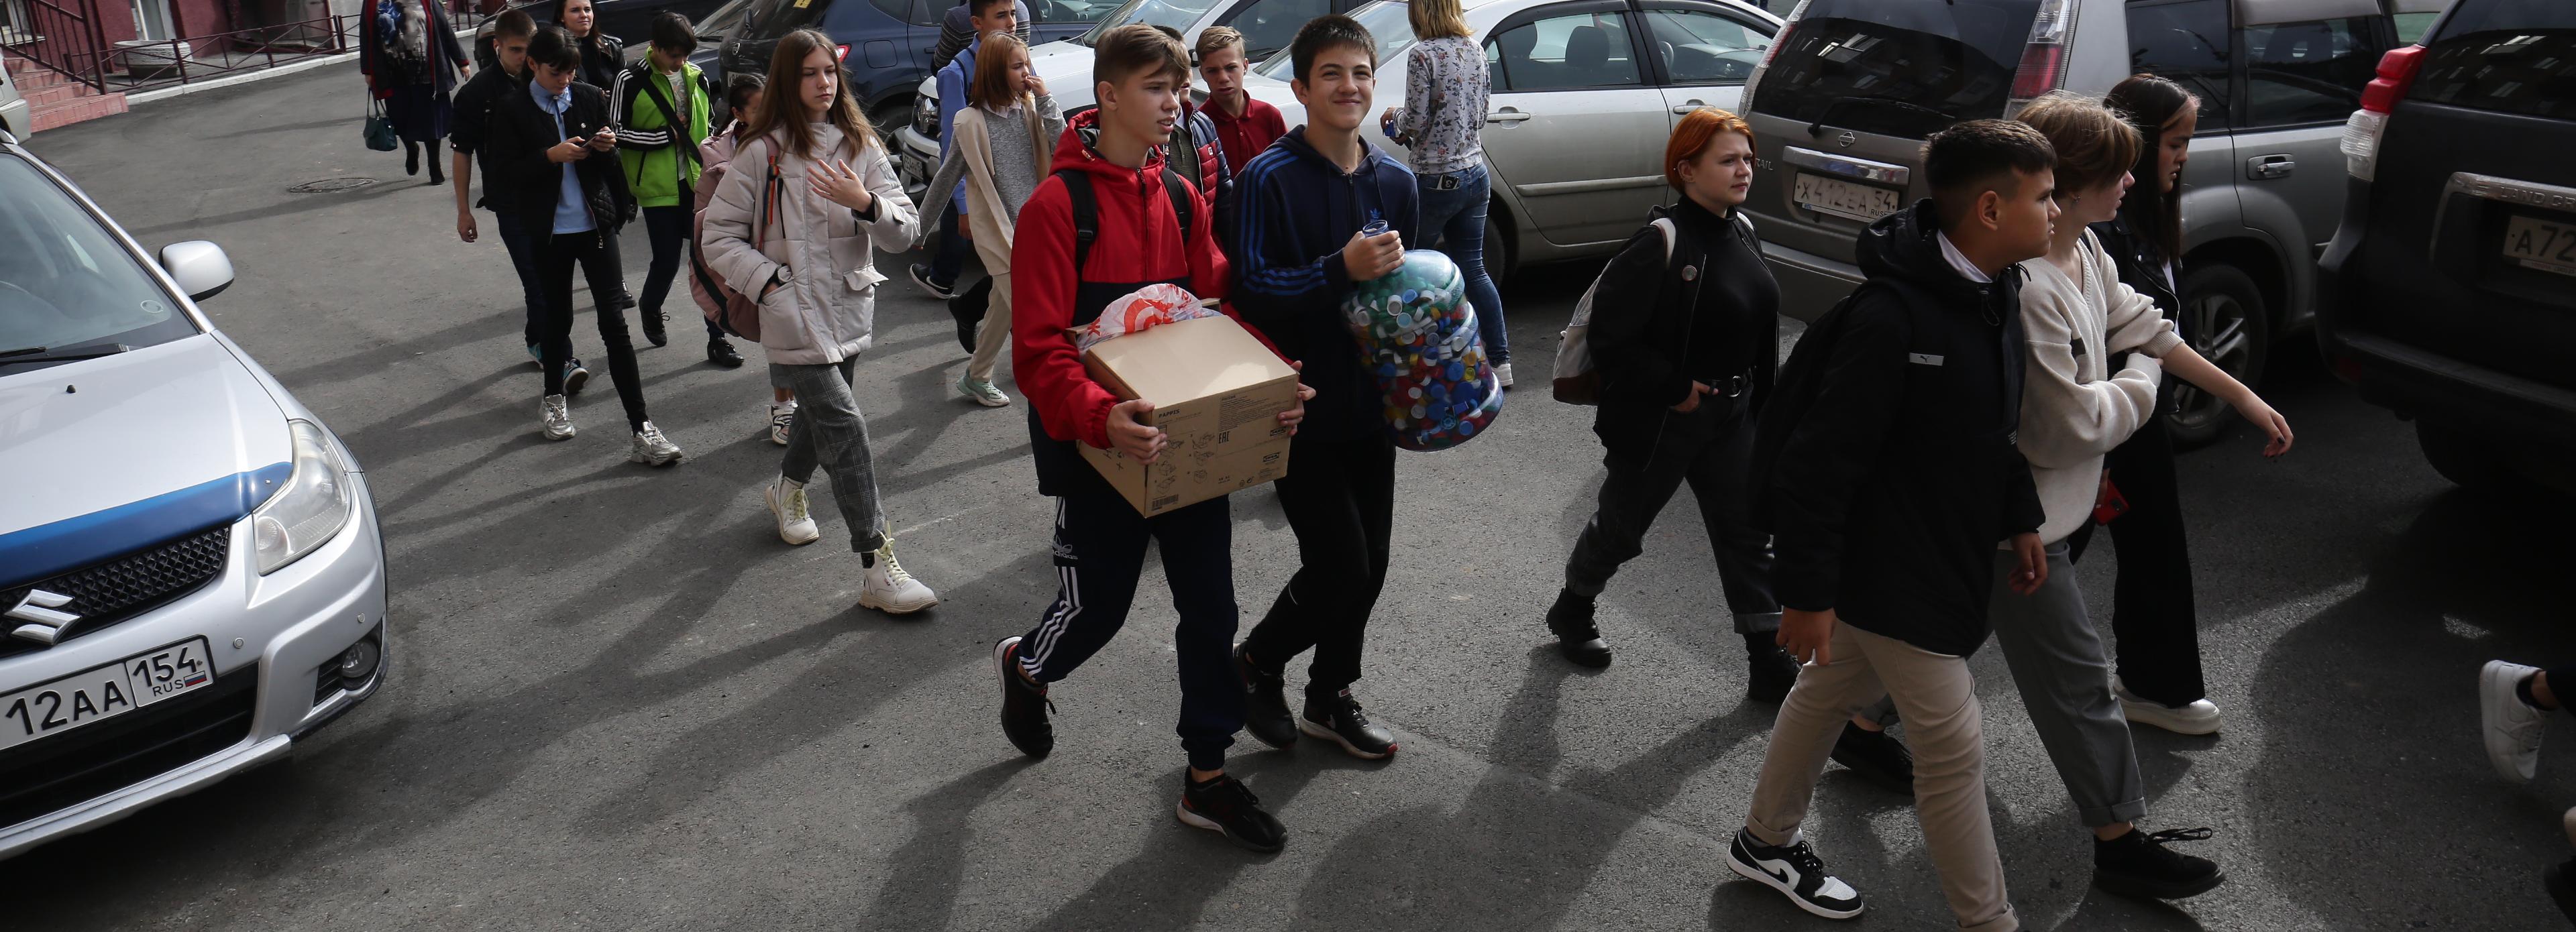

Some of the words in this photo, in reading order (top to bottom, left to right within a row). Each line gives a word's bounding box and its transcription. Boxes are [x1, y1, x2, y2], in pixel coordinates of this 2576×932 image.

[2500, 186, 2546, 203] LAND
[1159, 408, 1181, 418] PAPPIS
[1053, 550, 1078, 560] didas
[5, 680, 129, 736] 12AA
[133, 646, 197, 687] 154
[152, 679, 184, 697] RUS
